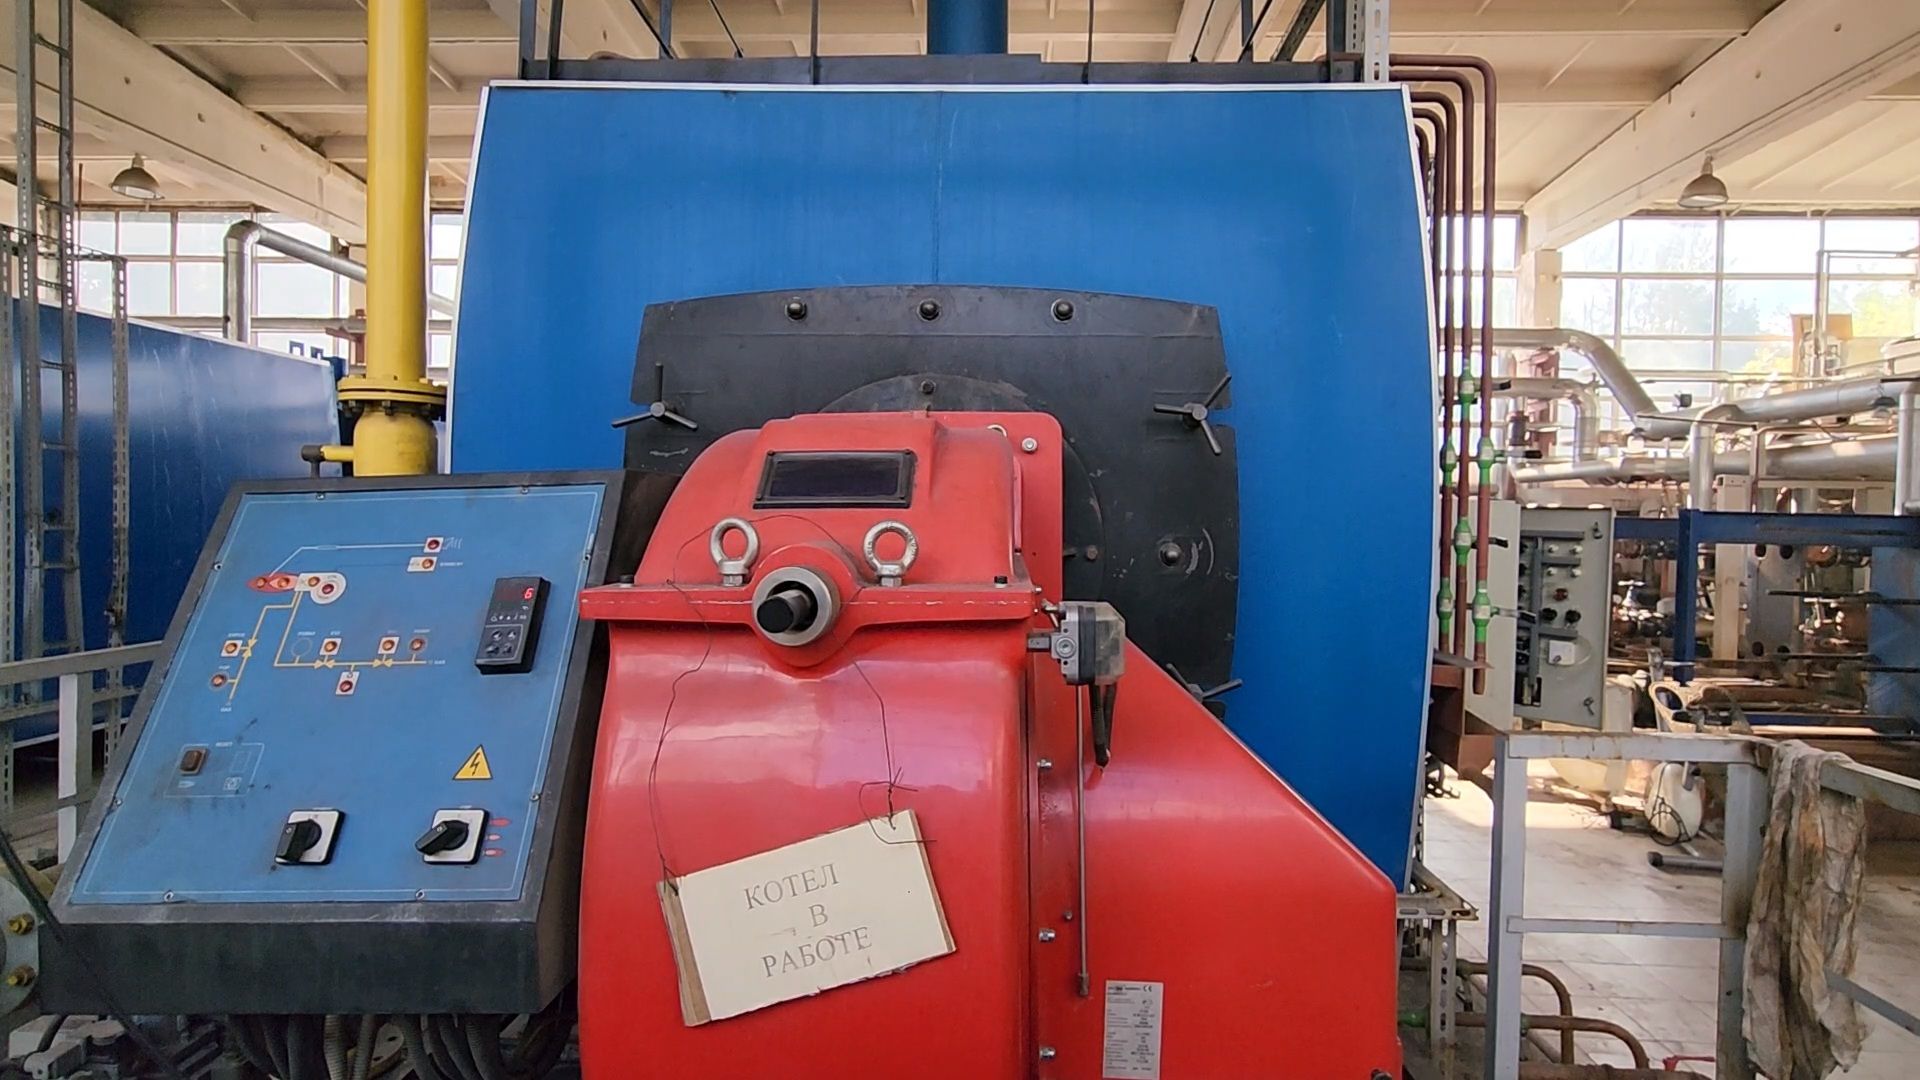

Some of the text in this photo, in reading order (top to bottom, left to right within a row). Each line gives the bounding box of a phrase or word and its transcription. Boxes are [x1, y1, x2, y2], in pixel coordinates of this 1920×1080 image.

[524, 588, 534, 599] 6
[744, 863, 840, 910] КОТЕЛ
[809, 904, 829, 927] В
[761, 926, 873, 978] РАБОТЕ
